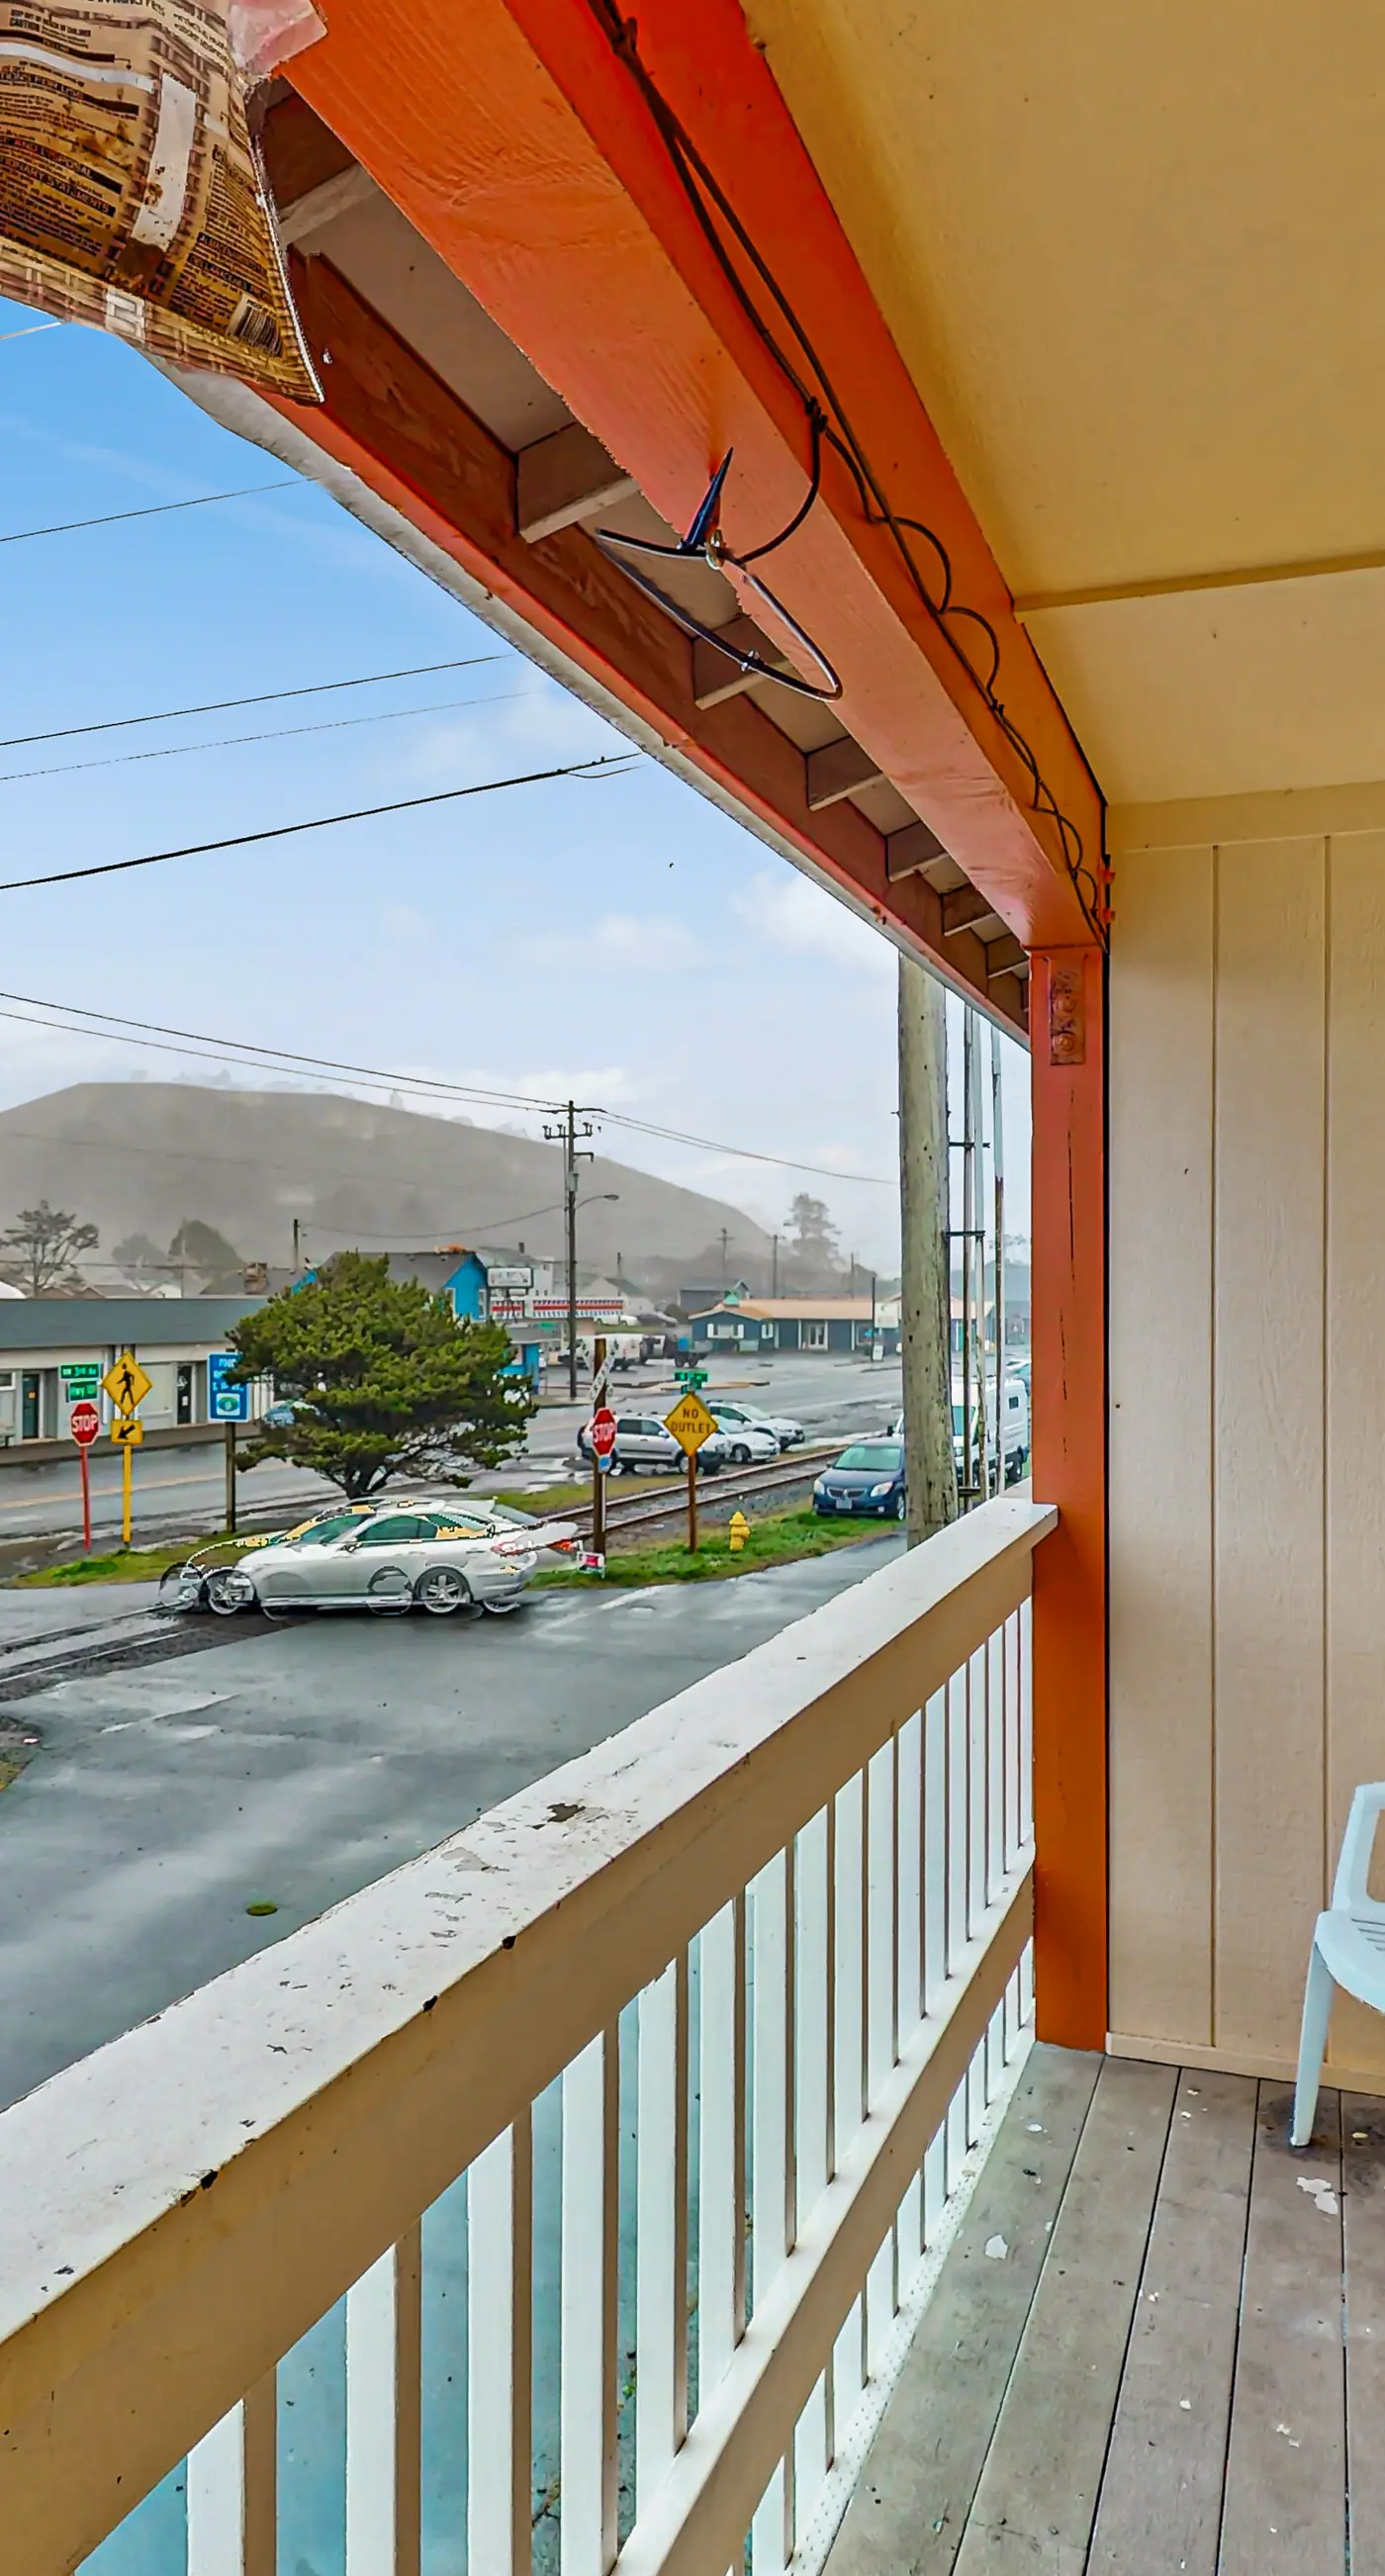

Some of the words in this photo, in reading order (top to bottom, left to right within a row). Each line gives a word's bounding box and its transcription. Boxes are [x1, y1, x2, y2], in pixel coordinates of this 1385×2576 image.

[683, 1409, 698, 1419] NO
[72, 1415, 98, 1433] STOP
[671, 1422, 710, 1433] OUTLET
[594, 1422, 615, 1442] STOP
